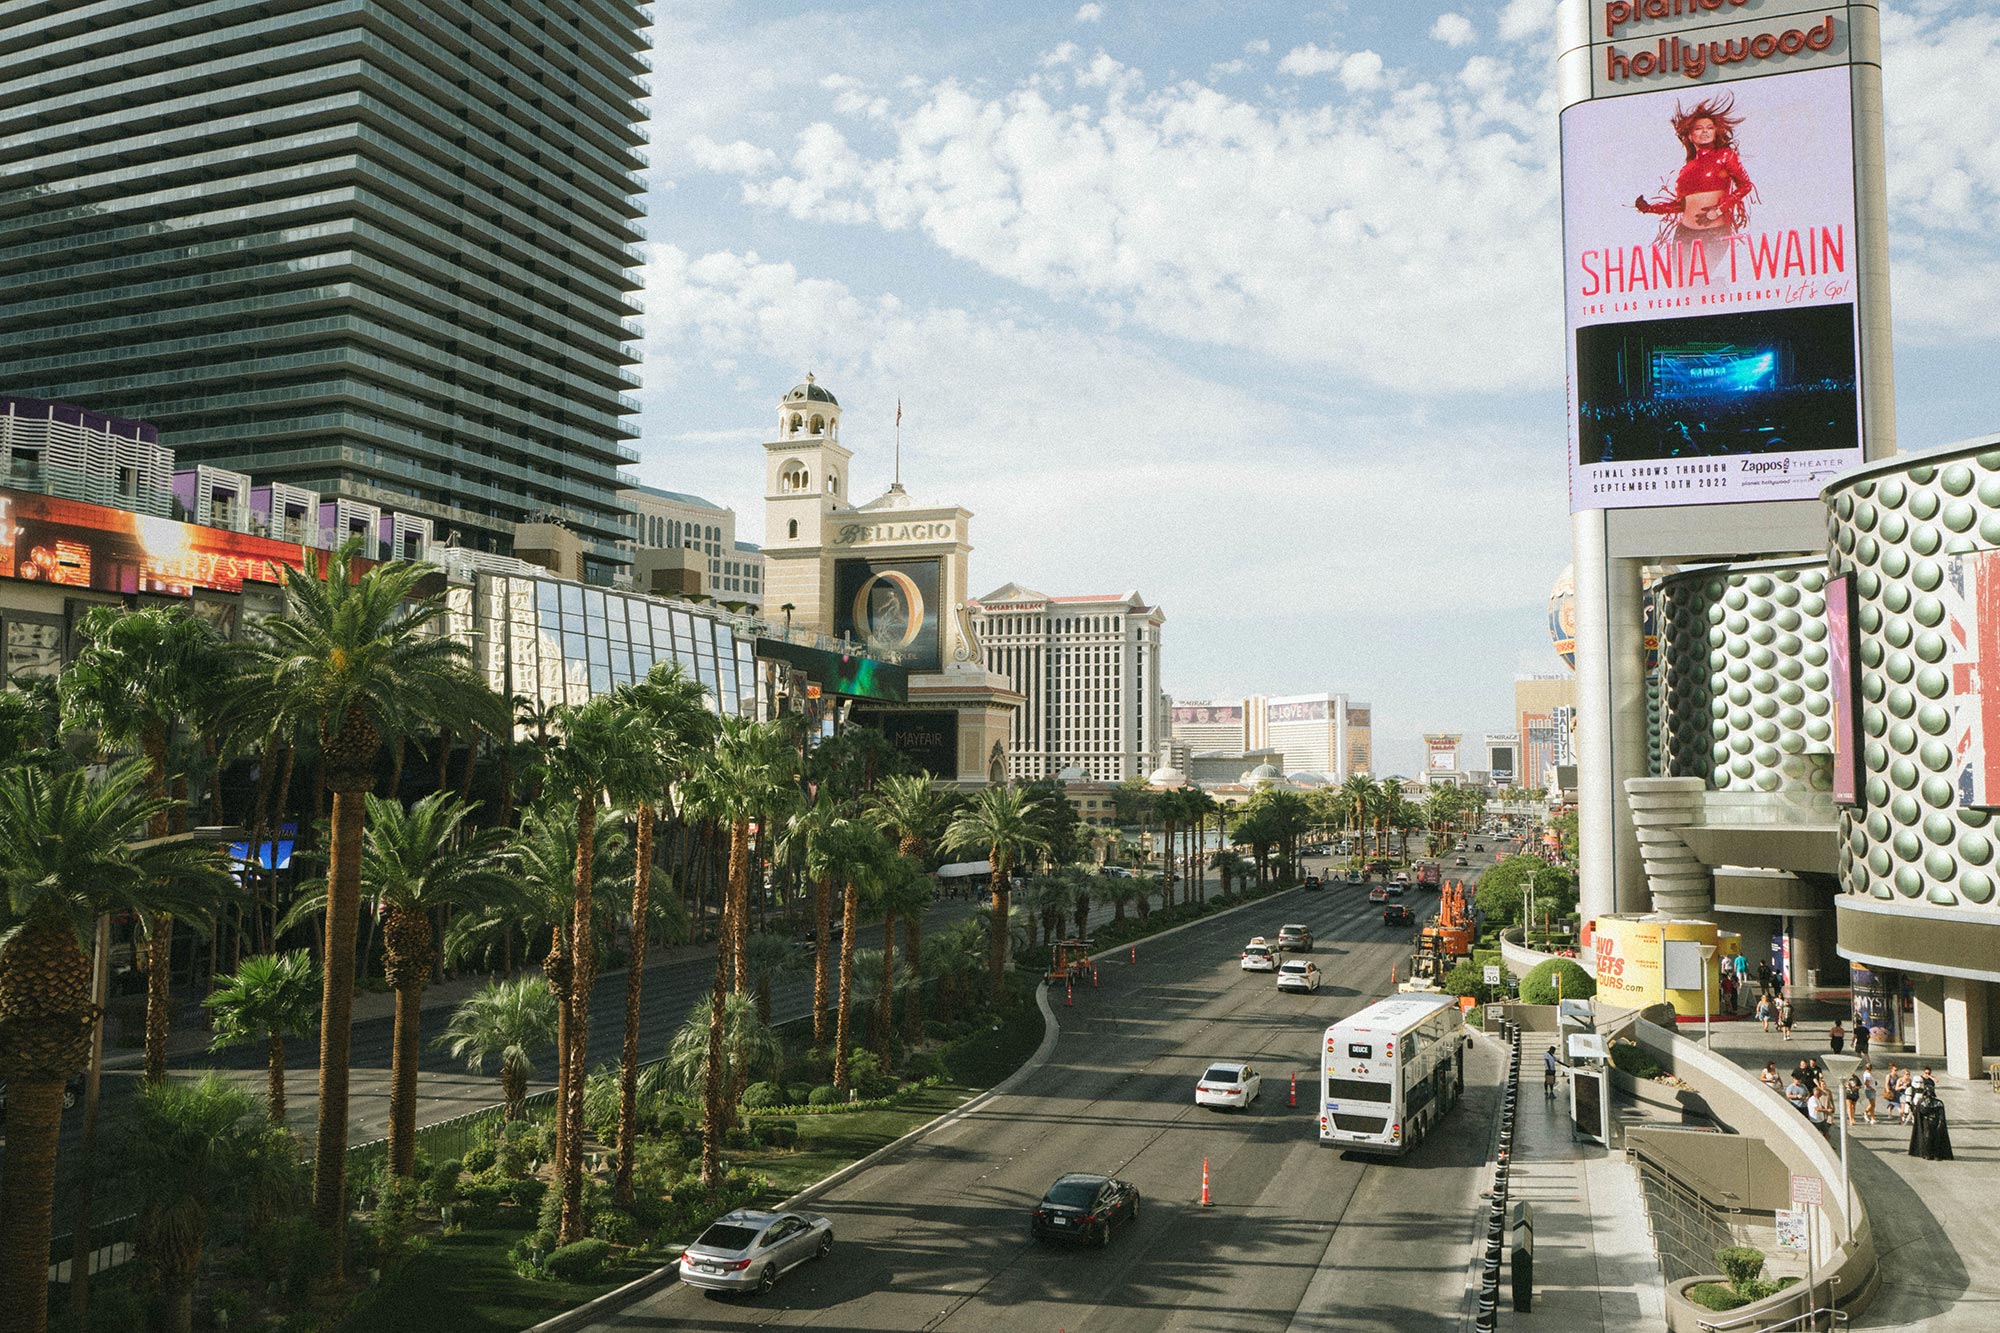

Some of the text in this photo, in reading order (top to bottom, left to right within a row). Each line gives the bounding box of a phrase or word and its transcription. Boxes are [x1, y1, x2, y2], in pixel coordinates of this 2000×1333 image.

[1606, 15, 1834, 80] hollywood
[1581, 224, 1845, 296] SHANIA TWAIN
[1784, 279, 1850, 304] Let's Go!
[1583, 288, 1781, 315] THE LAS VEGAS RESIDENCY
[1593, 463, 1726, 479] FINAL SHOWS THROUGH
[1741, 459, 1844, 474] Zappos THEATER
[1593, 477, 1727, 493] SEPTEMBER 10TH 2022
[833, 523, 951, 544] BELLAGIO
[1278, 704, 1302, 718] LOVE
[895, 731, 943, 747] MAYFAIR
[1486, 975, 1498, 983] 30
